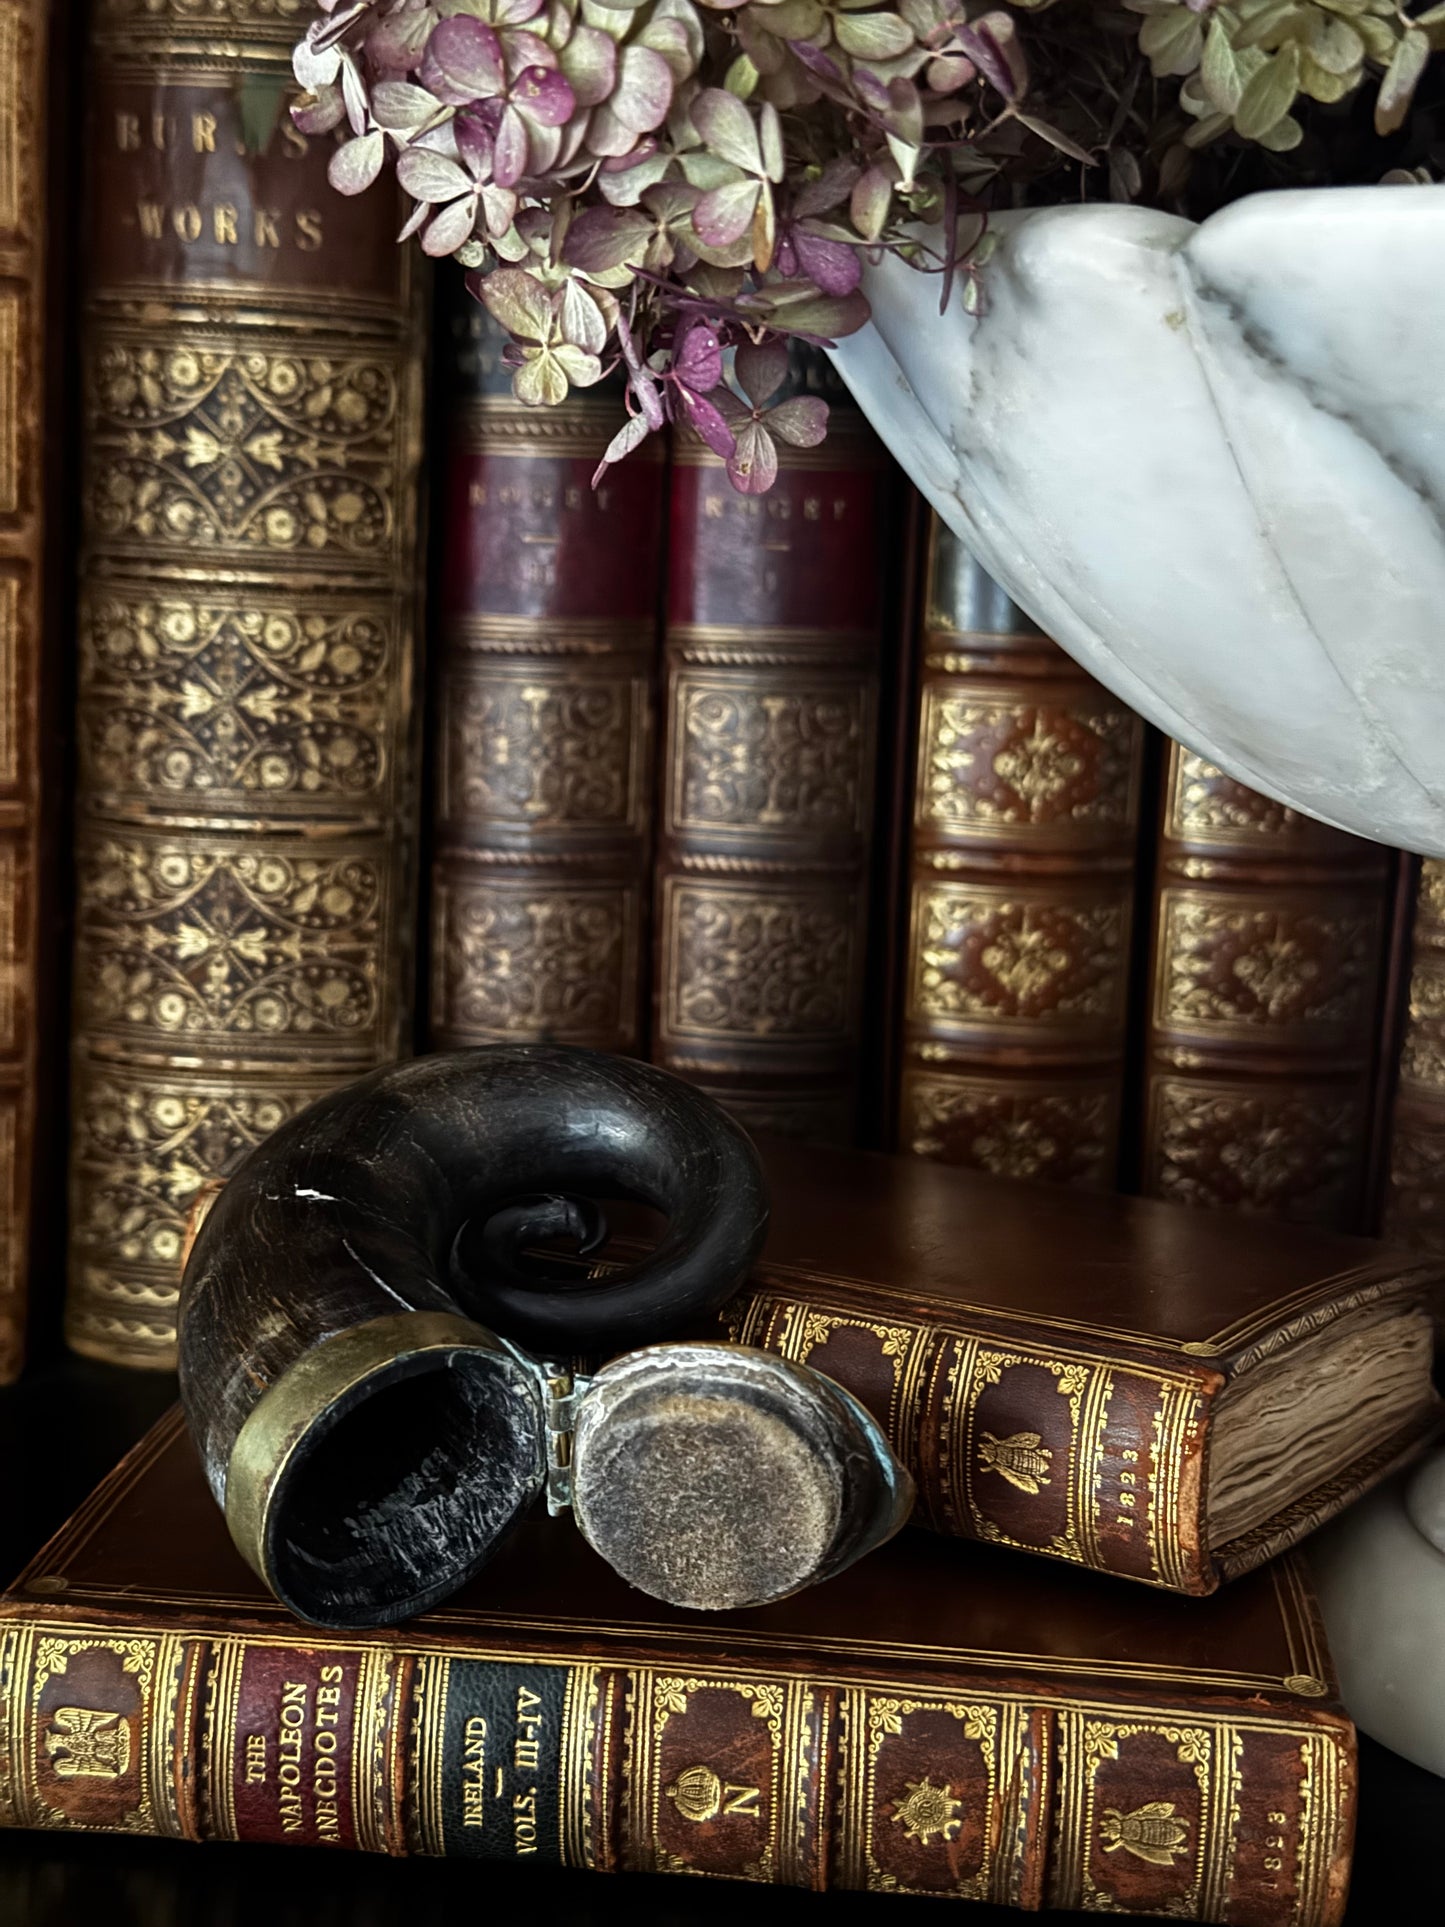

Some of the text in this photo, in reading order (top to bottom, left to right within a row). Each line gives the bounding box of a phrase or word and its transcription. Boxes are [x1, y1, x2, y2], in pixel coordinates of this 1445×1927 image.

[137, 200, 323, 251] WORKS
[1117, 1449, 1139, 1527] 1823
[245, 1735, 267, 1784] THE
[275, 1681, 308, 1834] NAPOLEON
[313, 1664, 344, 1843] ANECDOTES
[462, 1716, 488, 1828] IRELAND
[513, 1686, 542, 1856] VOLS. III-IV
[722, 1781, 760, 1818] N
